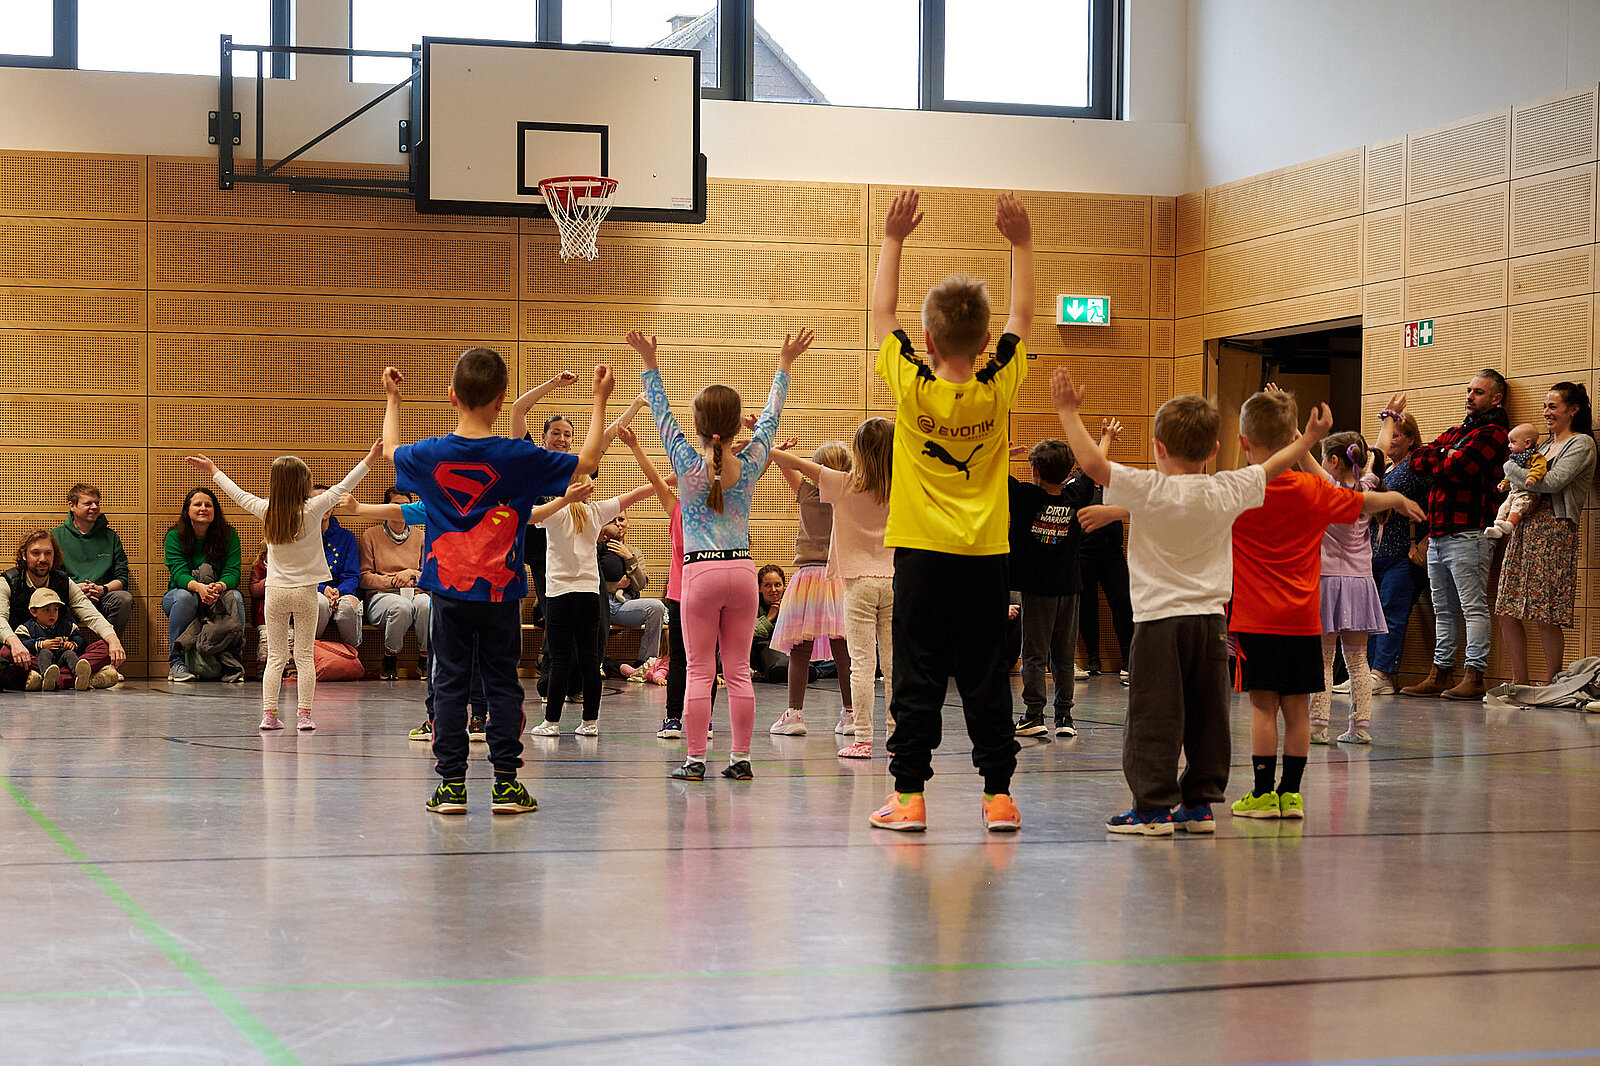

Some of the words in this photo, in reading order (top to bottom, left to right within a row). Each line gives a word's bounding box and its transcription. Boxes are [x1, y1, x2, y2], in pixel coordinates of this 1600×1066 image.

[939, 419, 995, 437] EVONIK
[1046, 505, 1070, 516] DIRTY
[1041, 535, 1057, 544] KIDS
